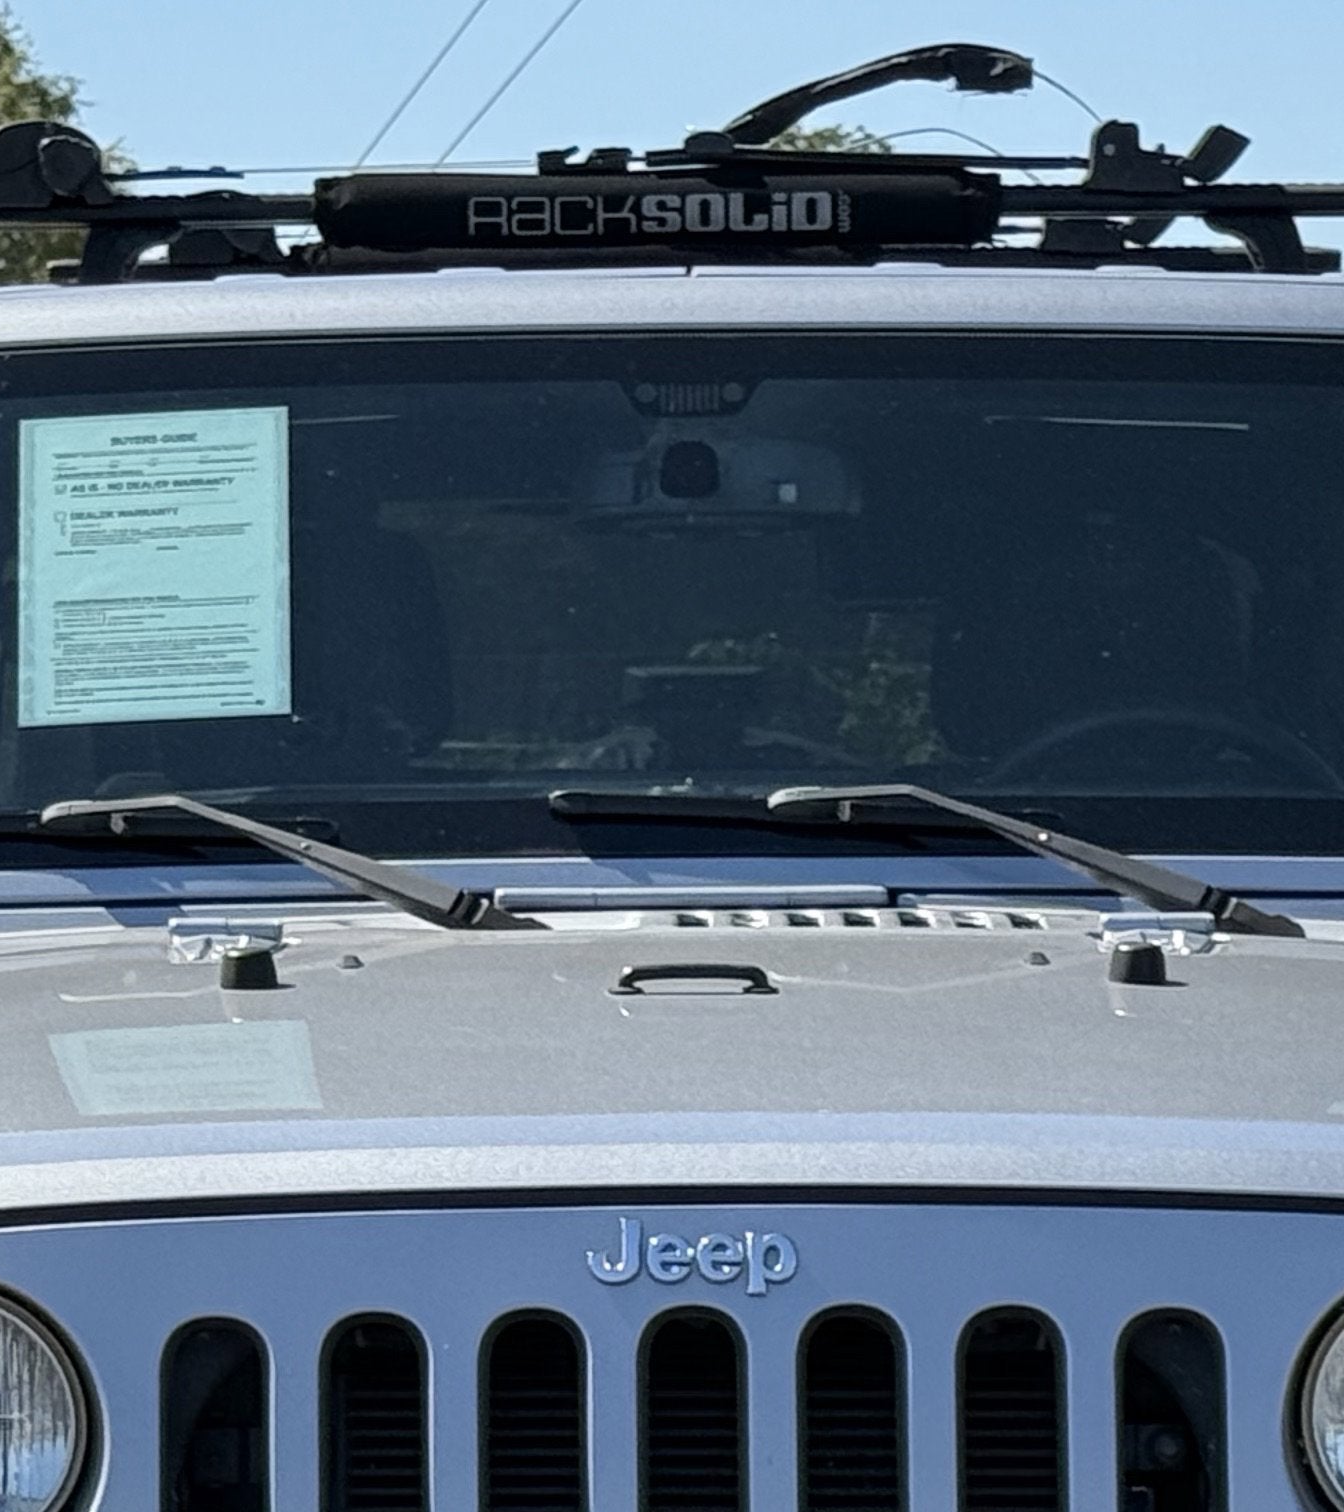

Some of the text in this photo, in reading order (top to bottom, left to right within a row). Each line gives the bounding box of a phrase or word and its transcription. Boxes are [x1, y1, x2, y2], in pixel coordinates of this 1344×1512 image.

[109, 432, 198, 447] BUYERS GUIDE
[172, 476, 236, 488] WARRANTY
[115, 507, 179, 518] WARRANTY
[585, 1216, 799, 1297] Jeep
